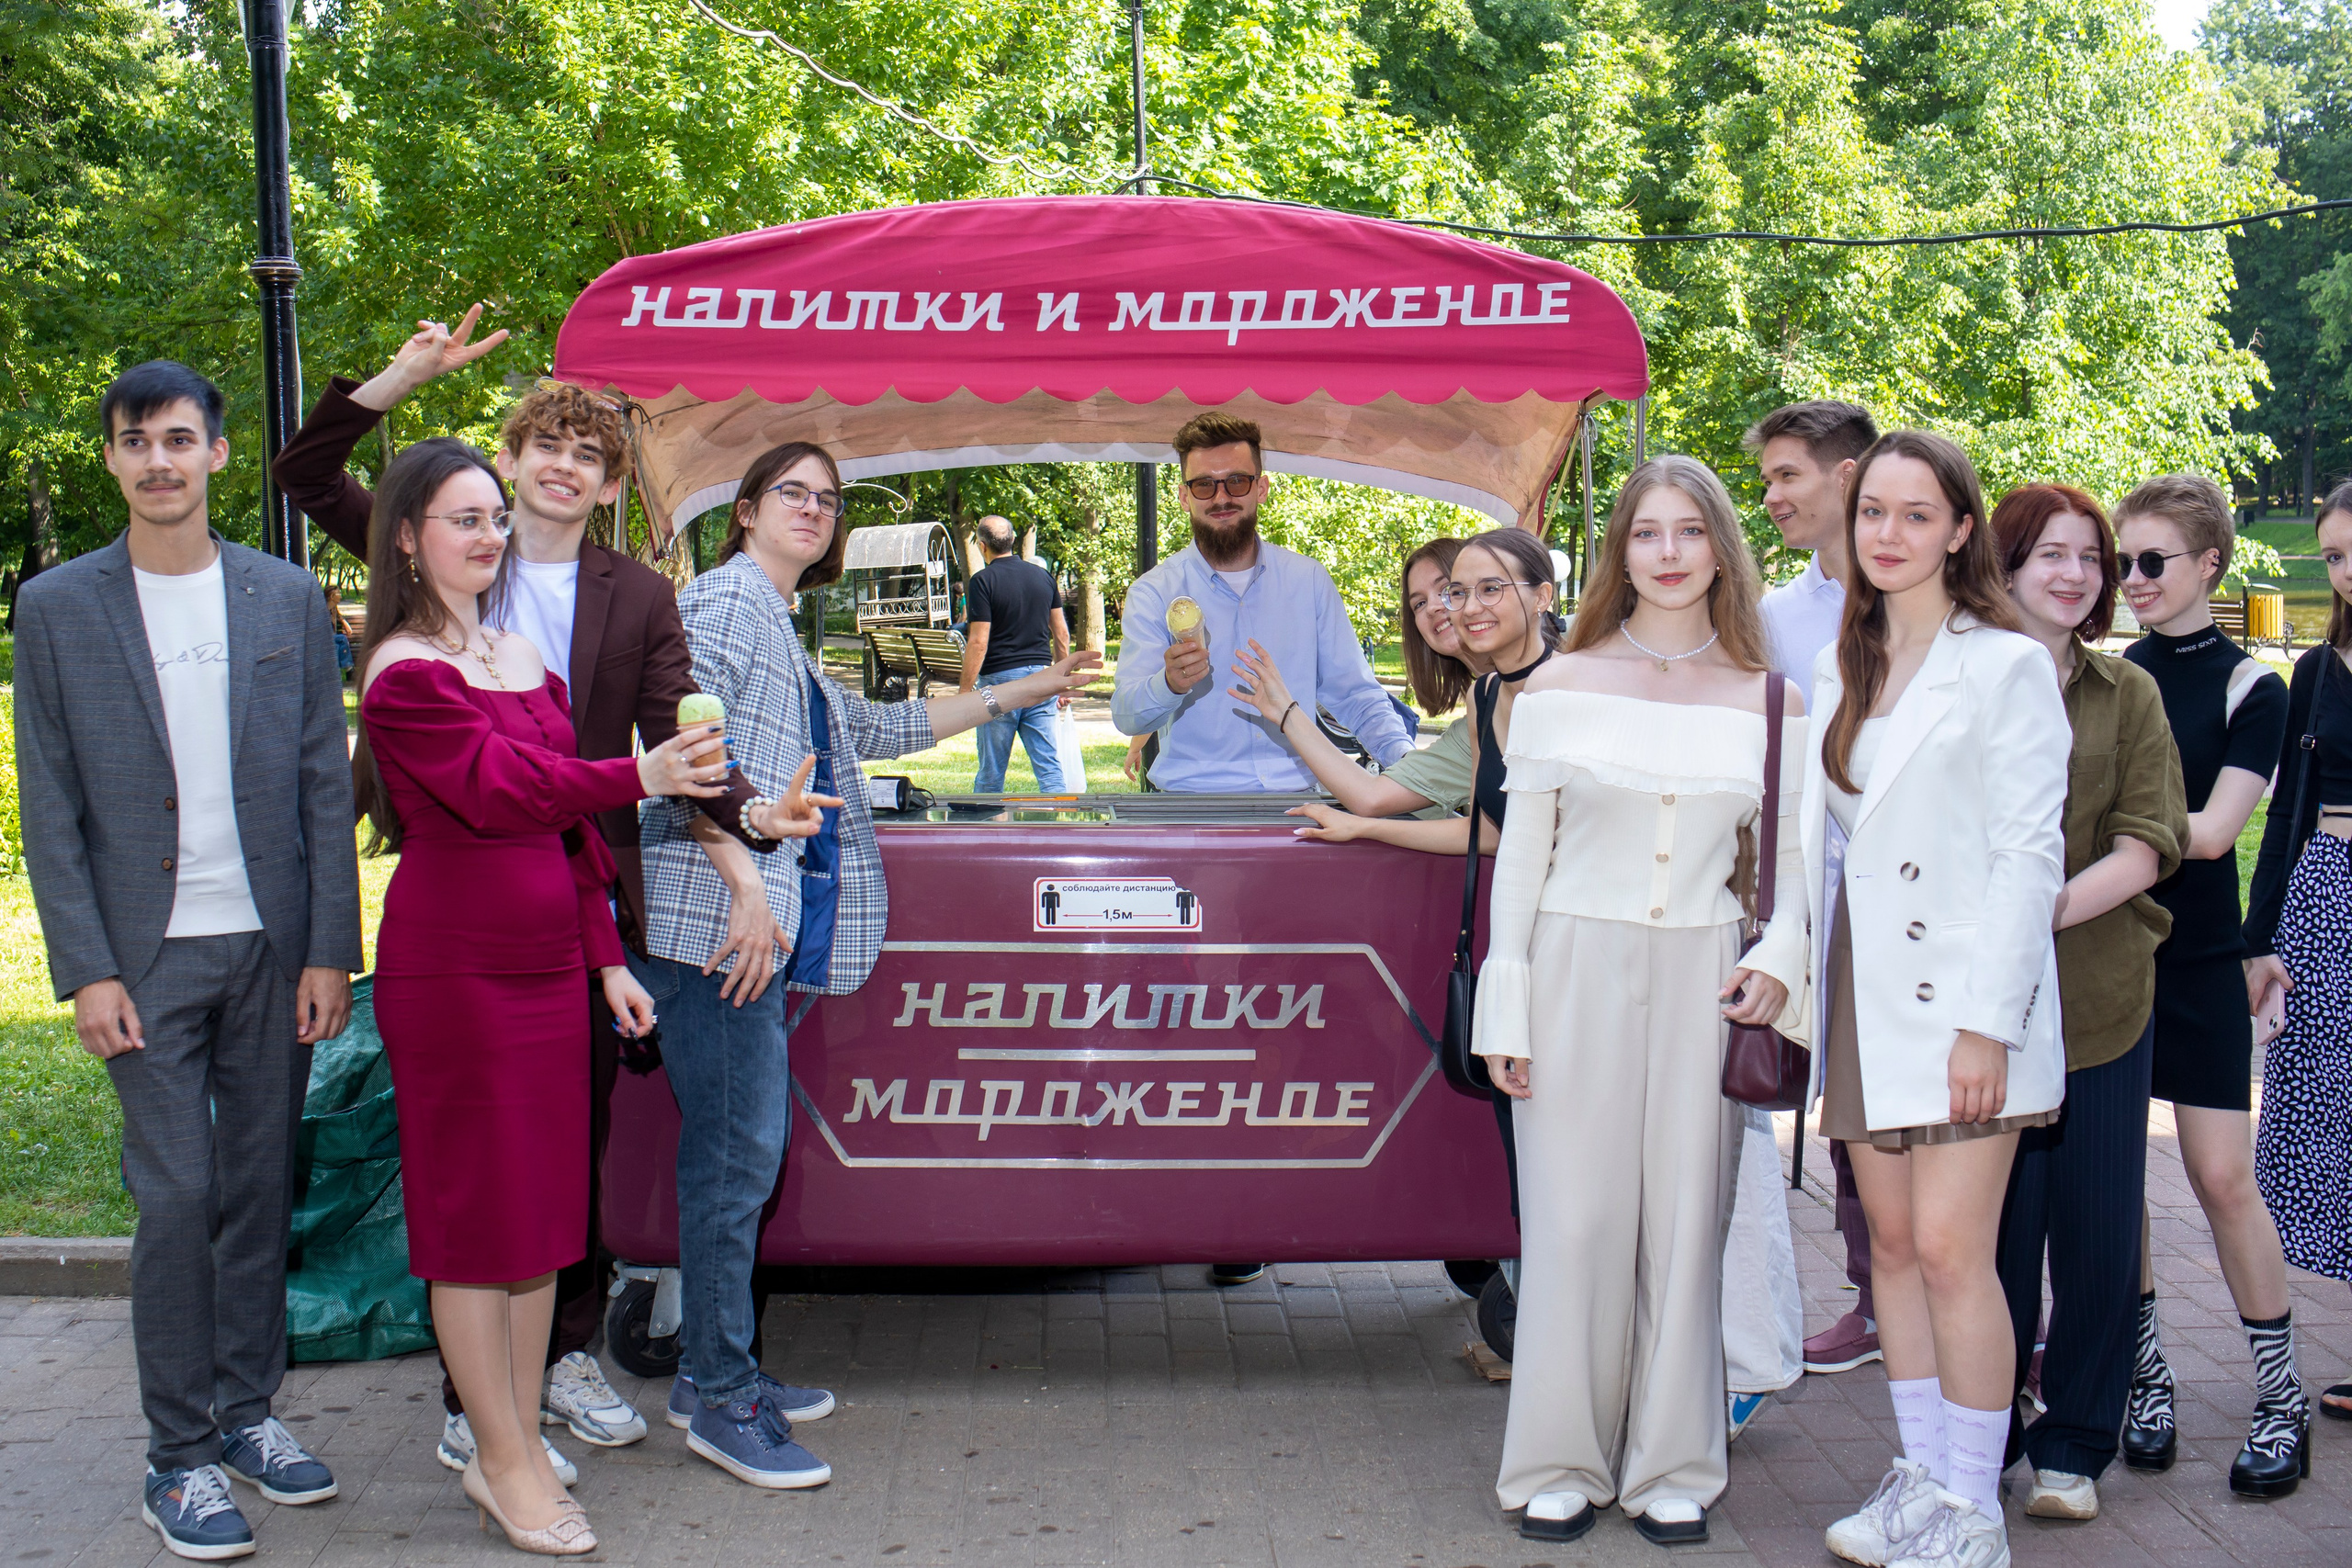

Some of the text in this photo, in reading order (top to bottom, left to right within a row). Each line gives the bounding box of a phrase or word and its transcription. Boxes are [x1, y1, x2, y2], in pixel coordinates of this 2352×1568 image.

[2175, 637, 2217, 653] MISS SIXTY
[1062, 884, 1121, 892] соблюдайте
